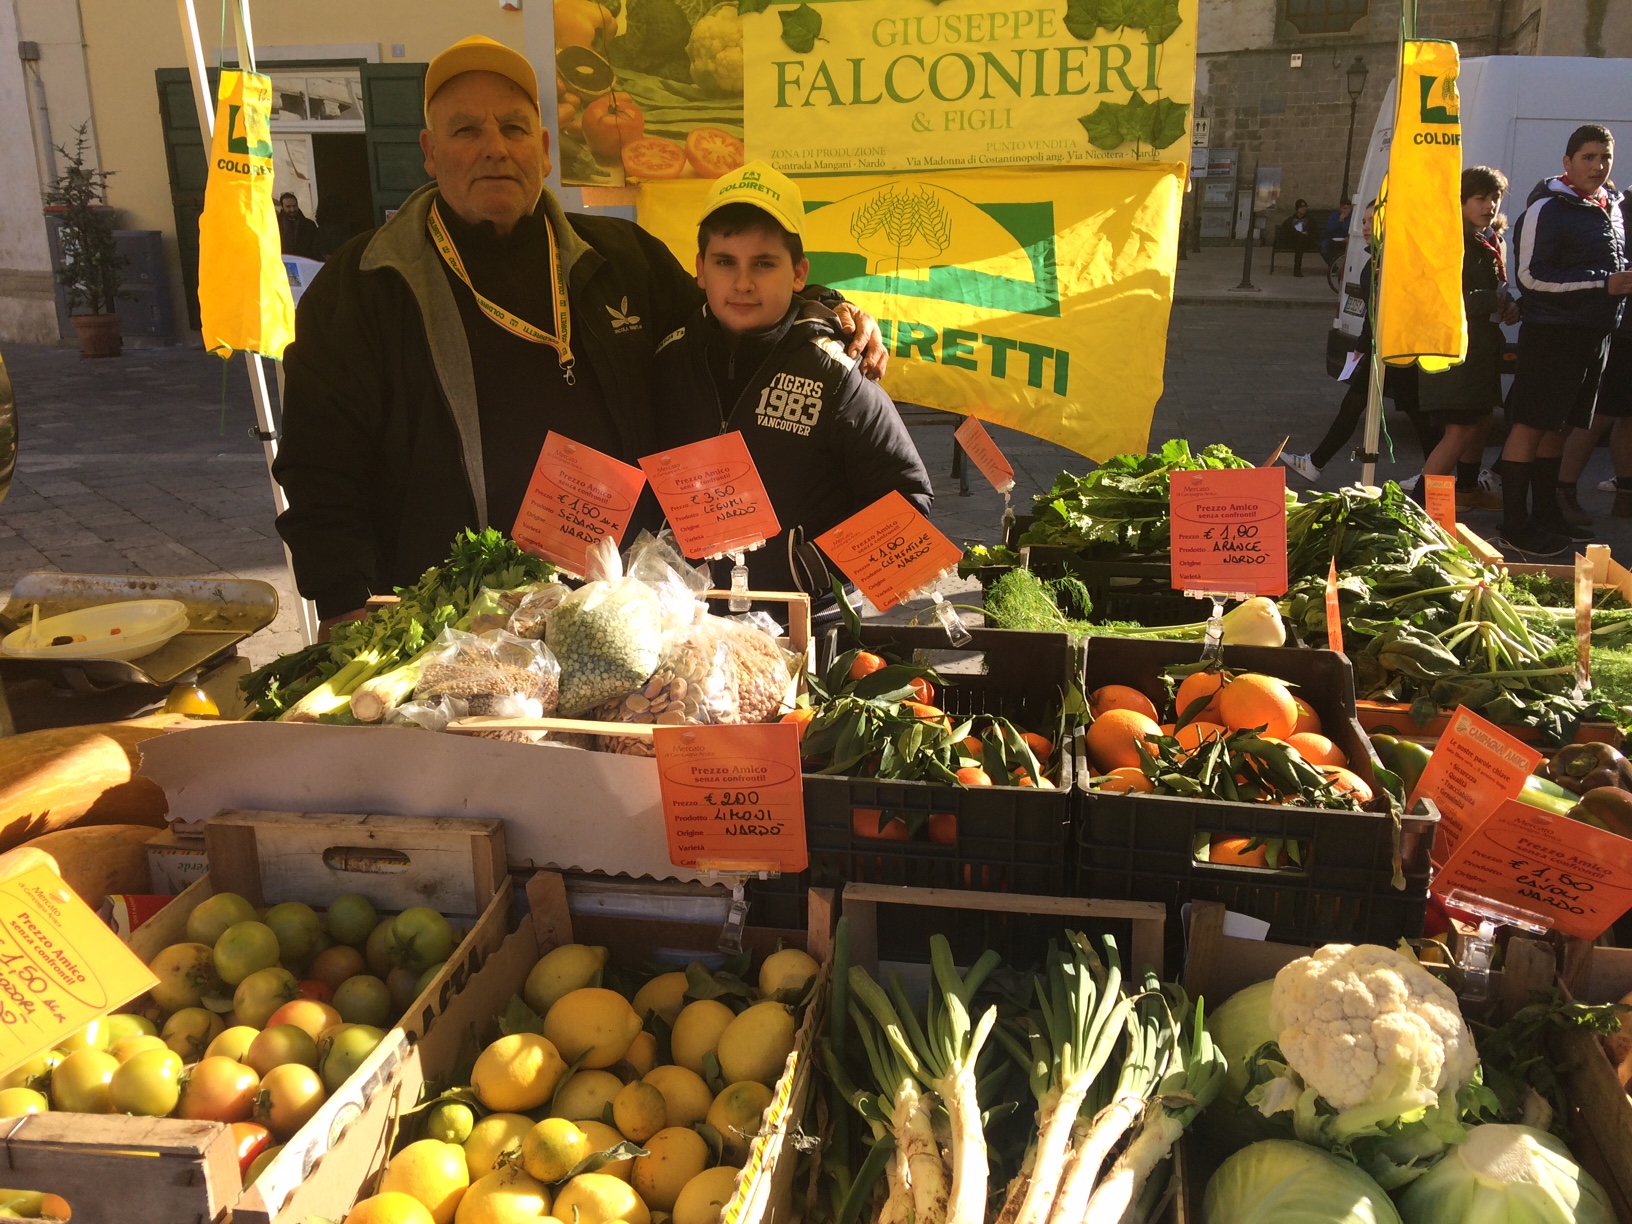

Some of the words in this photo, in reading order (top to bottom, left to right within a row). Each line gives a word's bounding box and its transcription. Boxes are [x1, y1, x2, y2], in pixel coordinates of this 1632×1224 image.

[872, 8, 1057, 48] GIUSEPPE
[771, 43, 1162, 108] FALCONIERI
[911, 111, 934, 133] &
[942, 108, 1014, 131] FIGLI
[770, 149, 799, 159] ZONA
[803, 148, 813, 158] DI
[814, 146, 886, 158] PRODUZIONE
[986, 141, 1026, 151] PUNTO
[1027, 139, 1077, 150] VENDITA
[771, 160, 812, 170] Contrada
[813, 160, 851, 171] Mangani
[858, 159, 886, 168] Nardò
[906, 157, 922, 166] Via
[923, 156, 966, 166] Madonna
[968, 154, 977, 164] di
[978, 152, 1044, 164] Costantinopoli
[1045, 153, 1065, 163] ang.
[1067, 151, 1082, 161] Via
[1085, 149, 1124, 160] Nicotera
[718, 181, 780, 201] COLDIRETTI
[878, 318, 1069, 397] IRETTI
[770, 372, 824, 398] TIGERS
[755, 386, 823, 427] 1983
[757, 414, 811, 437] VANCOUVER
[560, 470, 585, 487] Prezzo
[588, 483, 613, 499] Amico
[675, 474, 702, 486] Prezzo
[704, 466, 730, 478] Amico
[558, 479, 577, 491] senza
[577, 488, 609, 504] confronti!
[670, 503, 689, 512] Prezzo
[690, 494, 701, 505] €
[703, 485, 735, 504] 3,50
[535, 488, 553, 500] Prezzo
[557, 493, 569, 504] €
[568, 497, 600, 519] 1,50
[675, 513, 699, 522] Prodotto
[703, 497, 743, 514] LEGUMI
[1196, 504, 1227, 512] Prezzo
[1229, 503, 1259, 511] Amico
[526, 511, 546, 523] Origine
[530, 500, 554, 514] Prodotto
[557, 508, 605, 534] SEDANO
[522, 522, 541, 534] Varietà
[680, 524, 700, 533] Origine
[684, 534, 704, 543] Varietà
[851, 534, 876, 551] Prezzo
[876, 520, 898, 535] Amico
[1203, 528, 1215, 540] €
[517, 533, 543, 548] Categoria
[858, 542, 874, 554] senza
[874, 525, 900, 543] confronti!
[1212, 540, 1262, 552] ARANCE
[853, 563, 870, 575] Prezzo
[861, 567, 883, 583] Prodotto
[868, 577, 886, 590] Origine
[875, 586, 894, 598] Varietà
[1449, 738, 1458, 746] Le
[1457, 742, 1474, 758] nostre
[1473, 755, 1491, 771] parole
[1492, 766, 1511, 782] chiave
[1468, 727, 1504, 756] CAMPAGNA
[1504, 750, 1529, 772] AMICA
[691, 766, 729, 775] Prezzo
[731, 765, 768, 774] Amico
[1449, 771, 1468, 788] Qualità
[1453, 762, 1477, 784] Sicurezza
[703, 792, 717, 806] €
[1444, 779, 1476, 806] Tracciabilità
[1514, 817, 1555, 835] Mercato
[177, 862, 210, 873] Verde
[1471, 849, 1503, 864] Prezzo
[1508, 859, 1530, 870] €
[1516, 845, 1548, 860] senza
[1550, 856, 1606, 880] confronti!
[1518, 838, 1565, 858] Prezzo
[1568, 855, 1613, 876] Amico
[1454, 870, 1488, 885] Origine
[1462, 859, 1503, 877] Prodotto
[23, 887, 49, 914] Campagna
[47, 910, 62, 928] Amica
[31, 886, 62, 918] Mercato
[9, 920, 35, 946] senza
[34, 945, 76, 987] confronti!
[17, 912, 53, 949] Prezzo
[51, 948, 86, 983] Amico
[1, 953, 48, 994] 1,50
